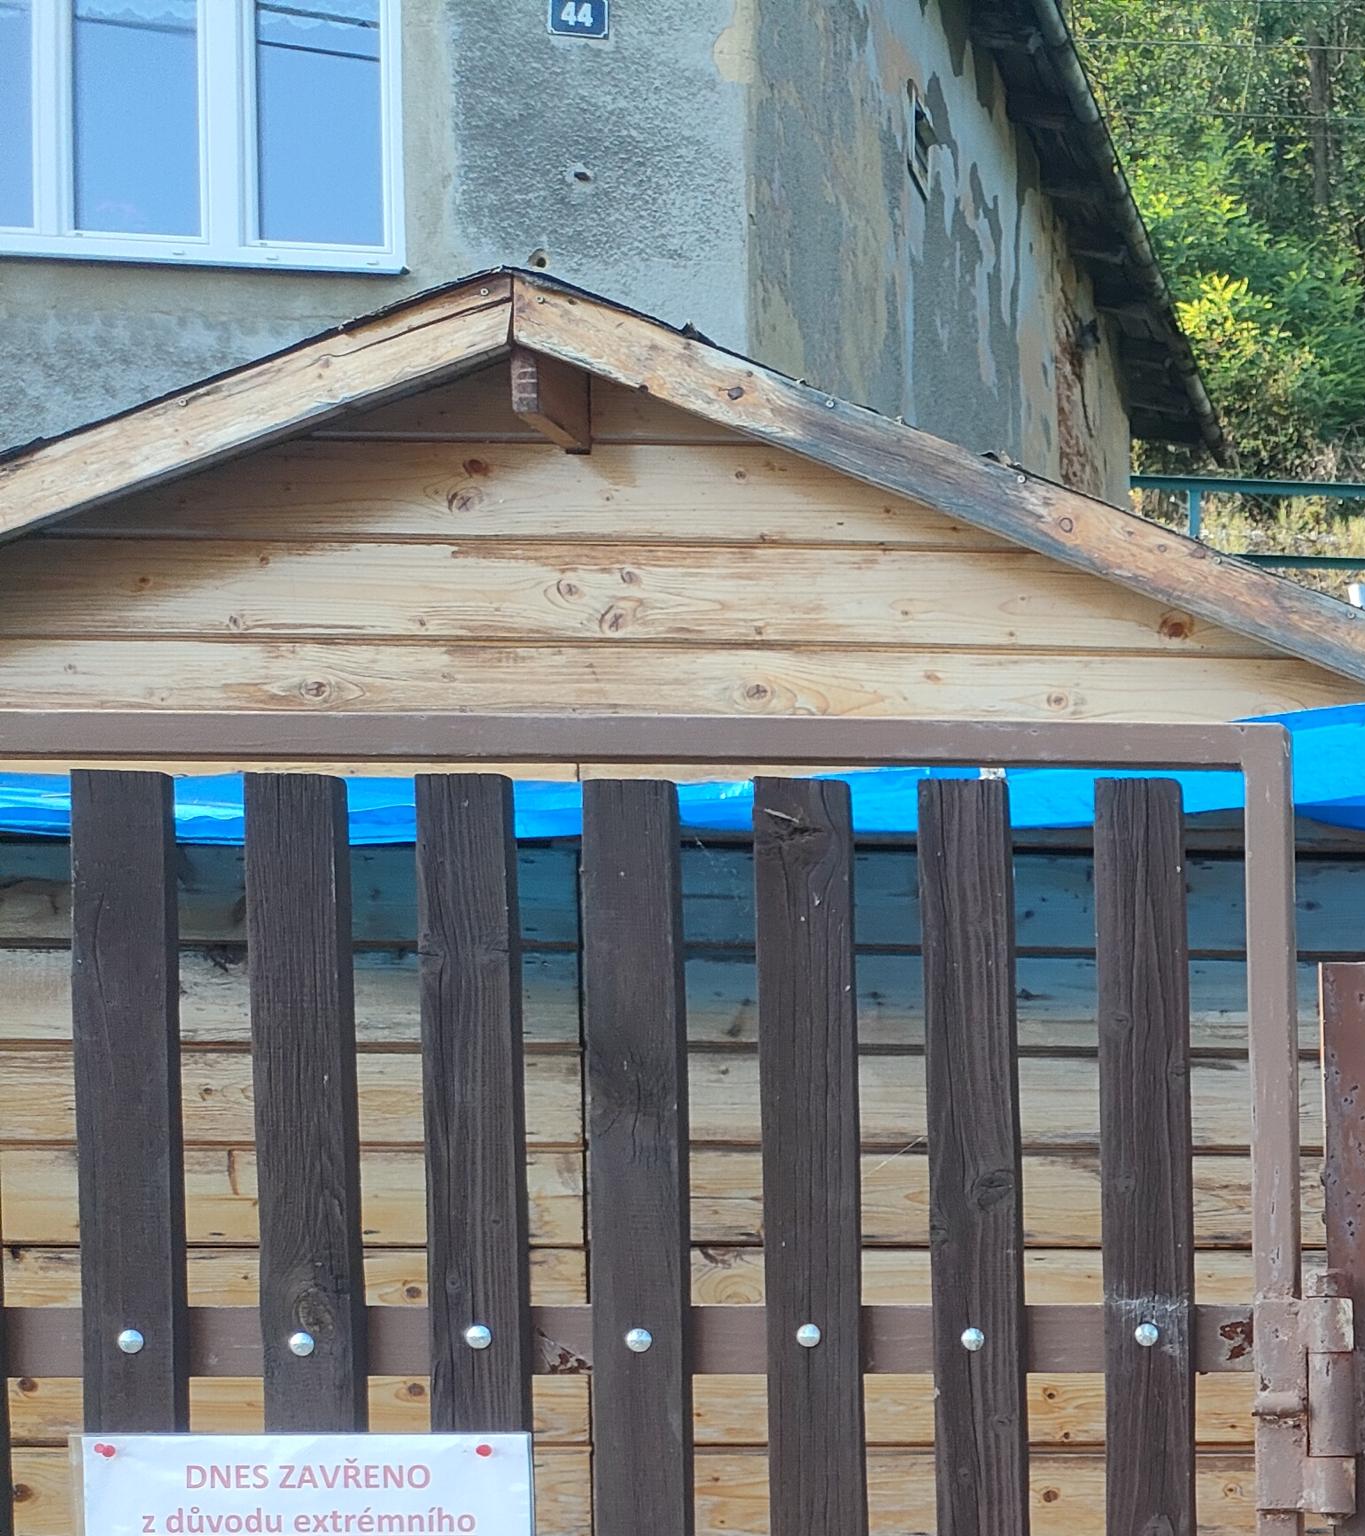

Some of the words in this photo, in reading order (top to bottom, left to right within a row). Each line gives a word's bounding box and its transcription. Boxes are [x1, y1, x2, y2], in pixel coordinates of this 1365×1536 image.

[560, 1, 594, 27] 44
[185, 1464, 268, 1489] DNES
[279, 1458, 431, 1490] ZAVŘENO
[142, 1516, 156, 1533] z
[166, 1507, 283, 1534] důvodu
[294, 1507, 476, 1534] extrémního
